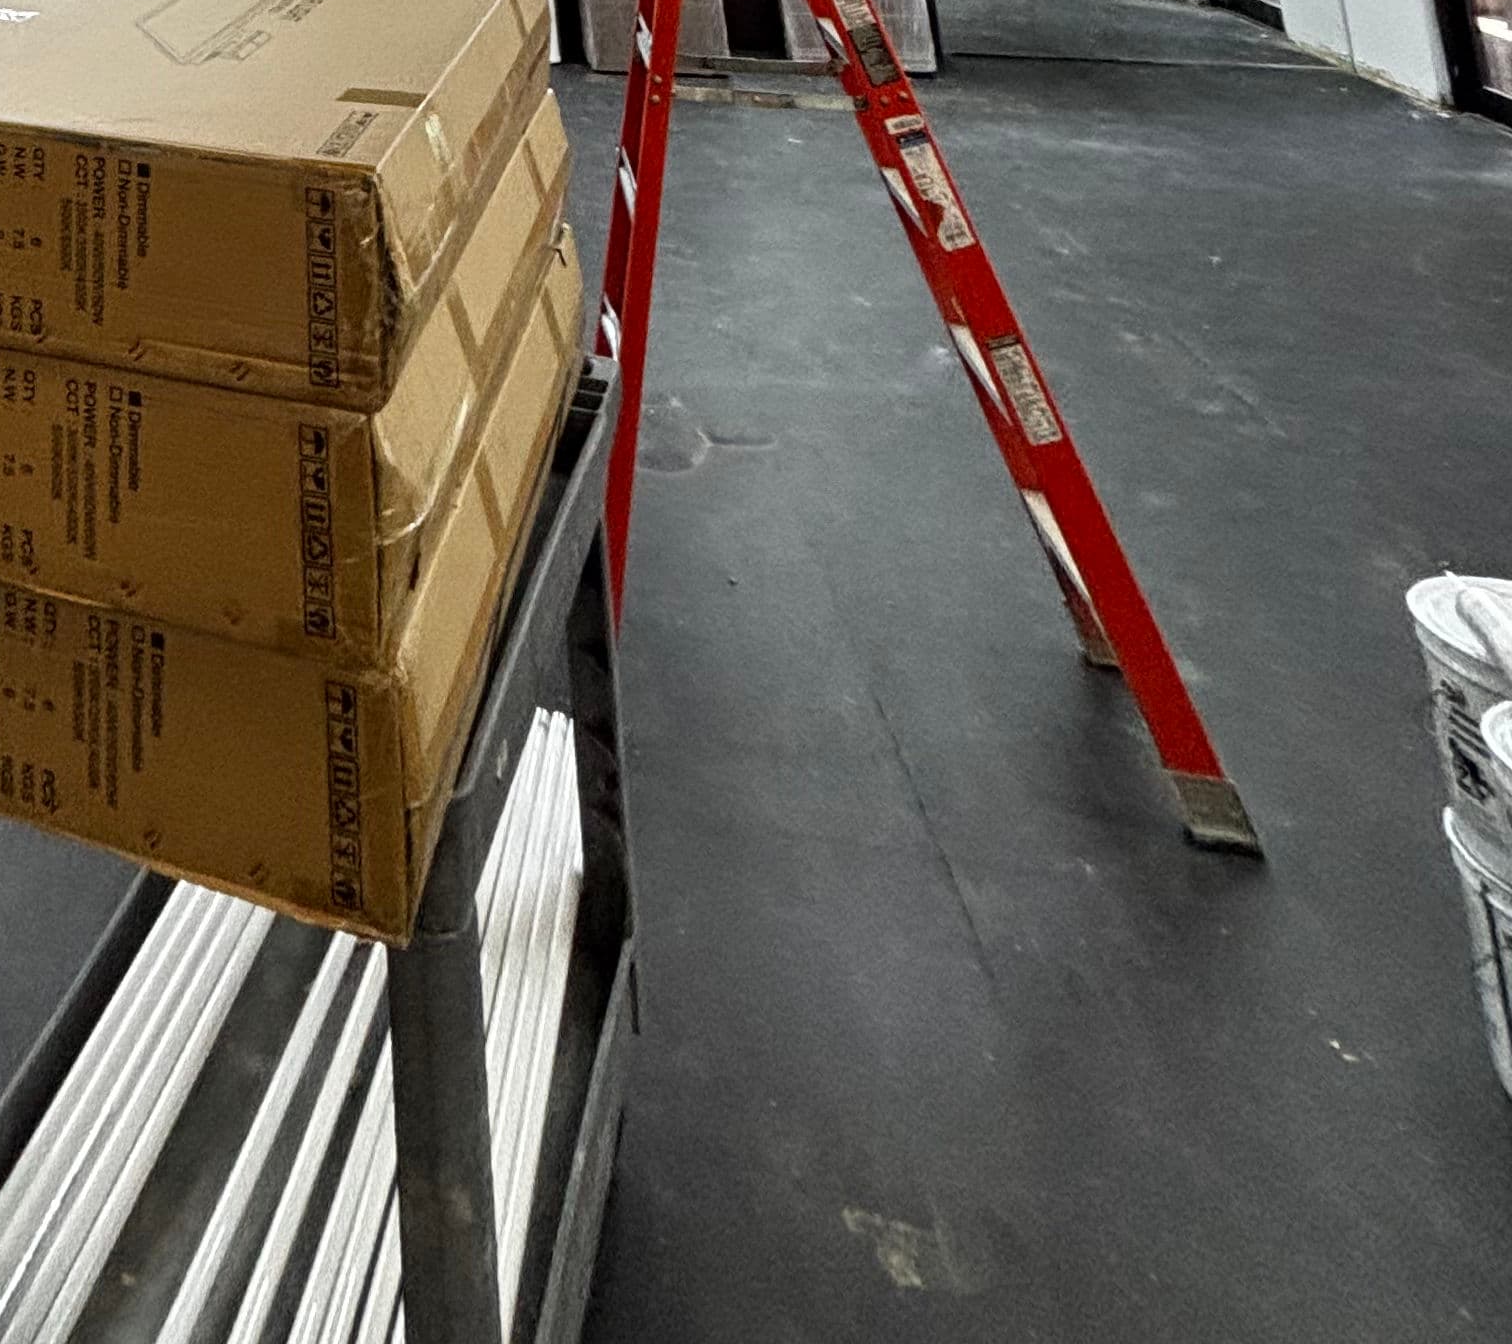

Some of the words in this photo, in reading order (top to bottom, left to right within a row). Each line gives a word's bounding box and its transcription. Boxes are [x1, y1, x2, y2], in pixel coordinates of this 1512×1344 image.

[117, 178, 132, 290] Non-Dimmable
[137, 182, 151, 258] Dimmable
[10, 295, 22, 331] KGS
[30, 299, 43, 334] PCS
[1, 523, 13, 562] KGS
[21, 528, 34, 566] PCS
